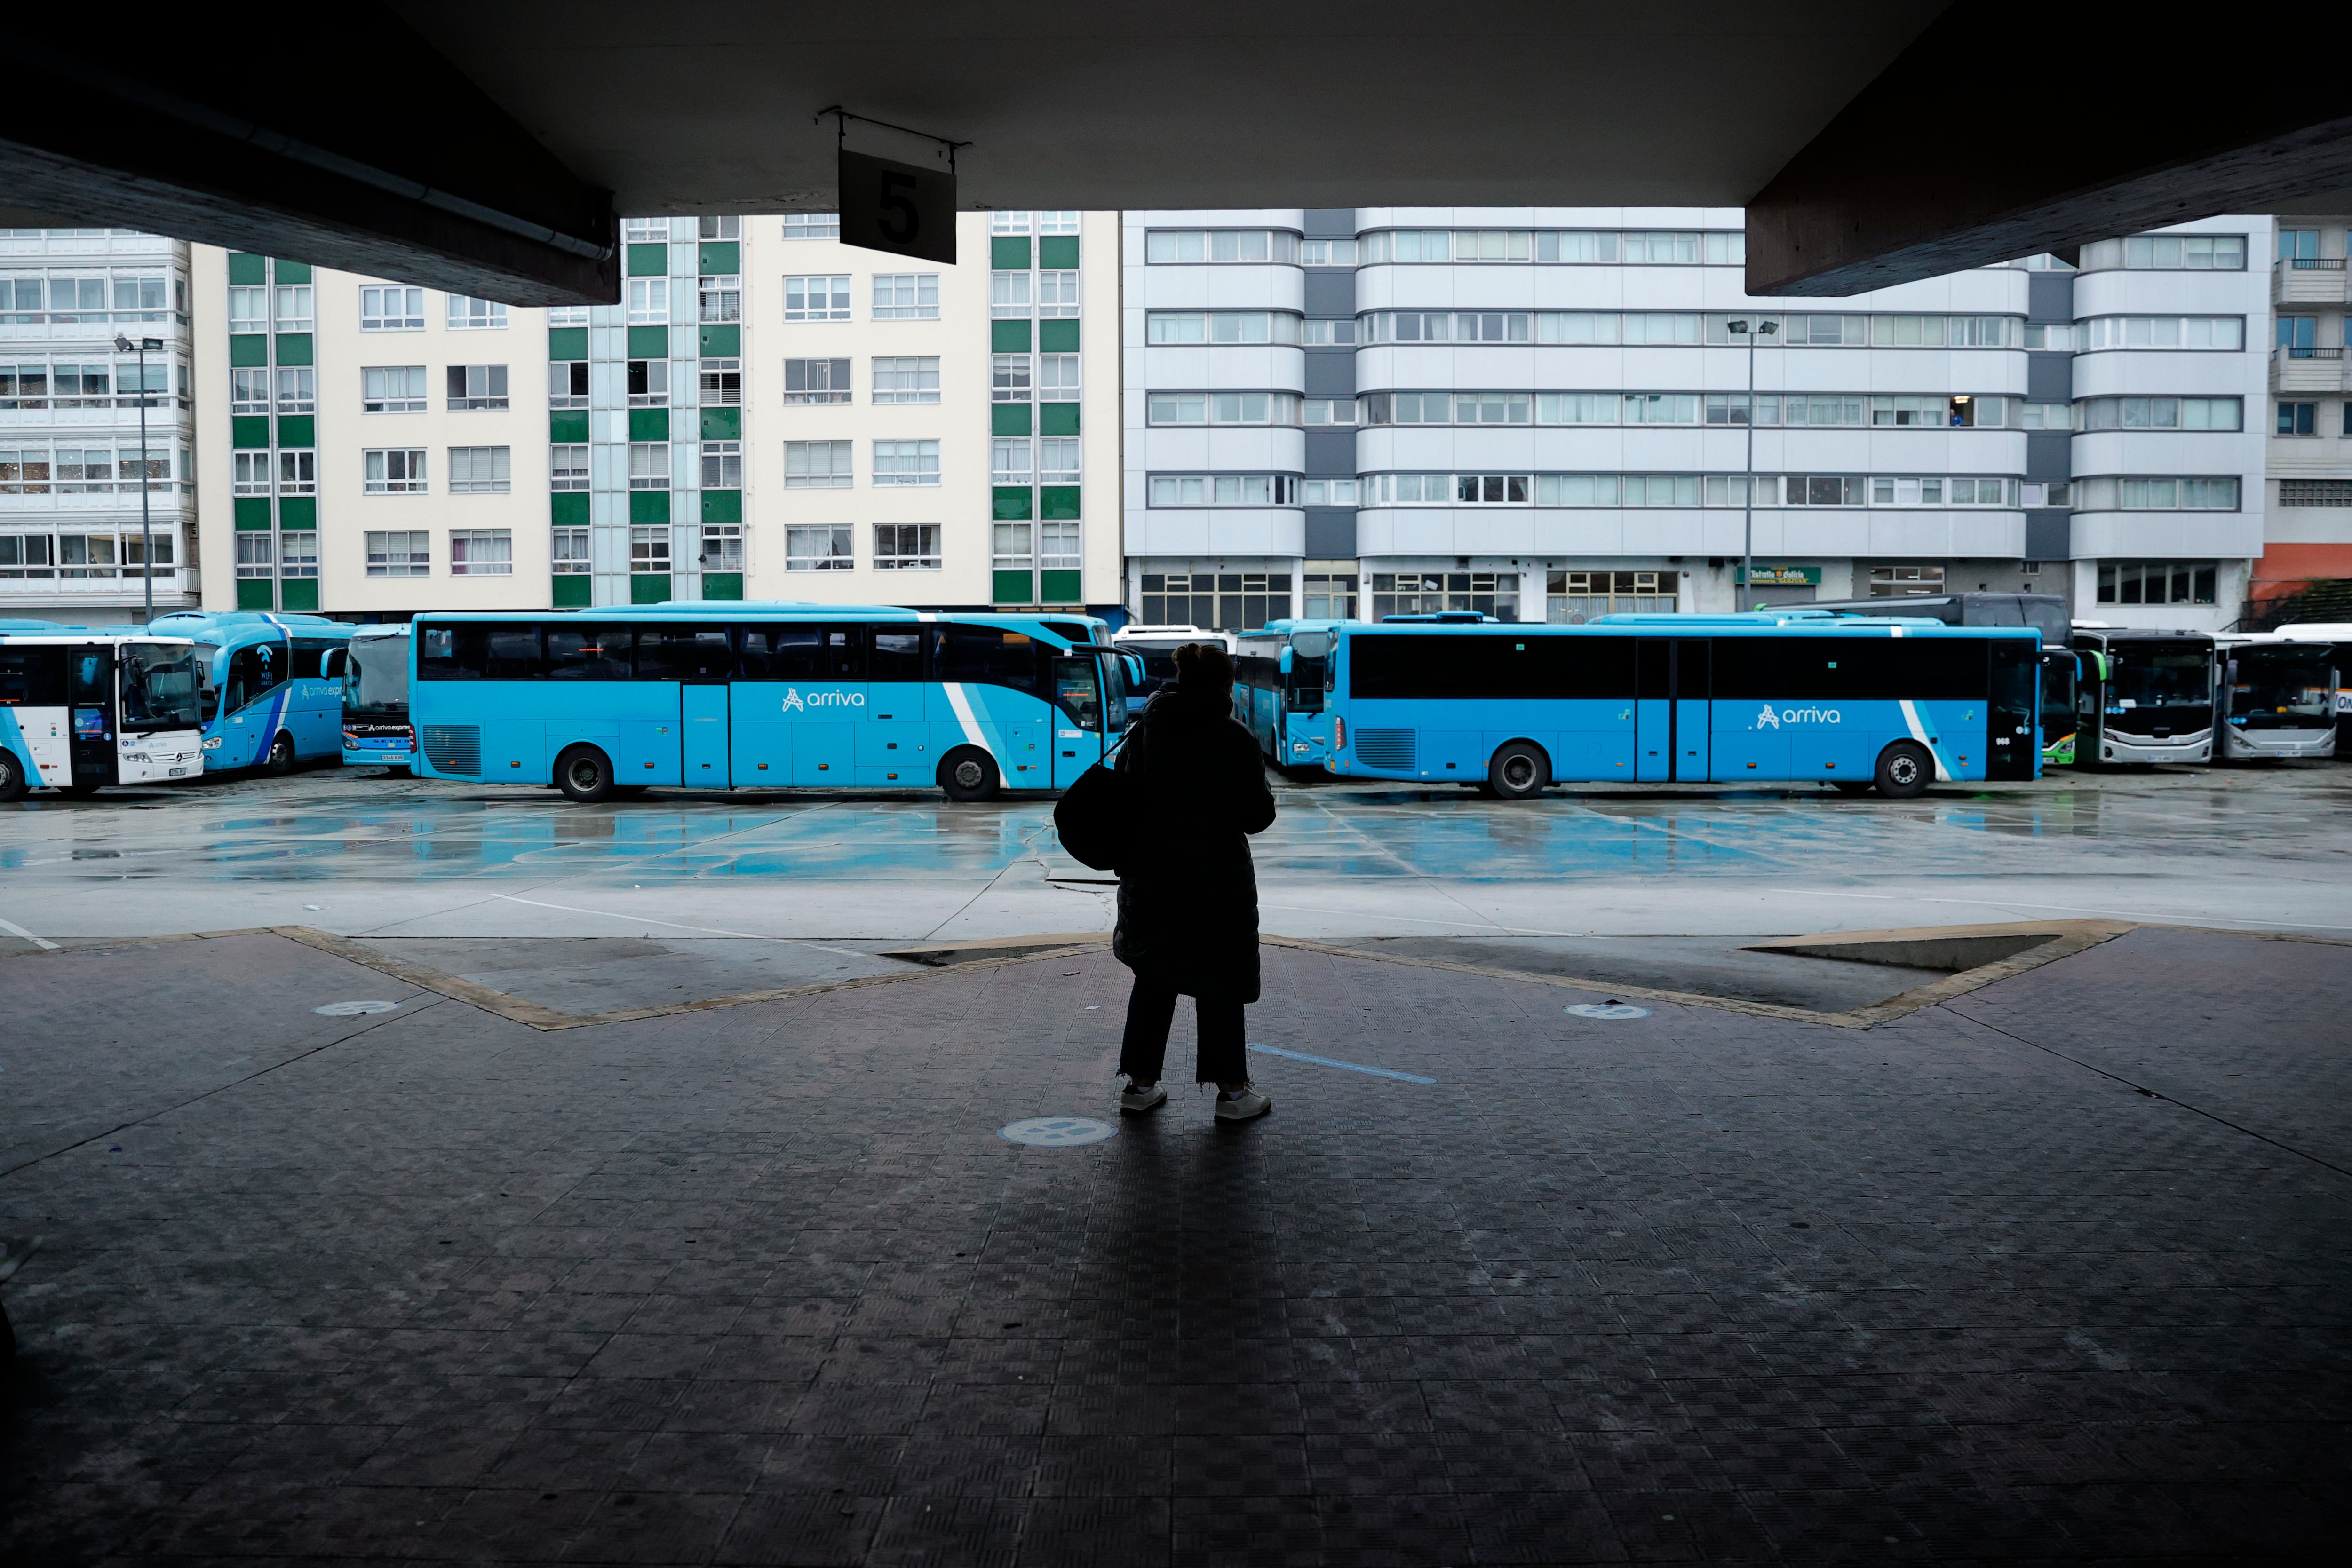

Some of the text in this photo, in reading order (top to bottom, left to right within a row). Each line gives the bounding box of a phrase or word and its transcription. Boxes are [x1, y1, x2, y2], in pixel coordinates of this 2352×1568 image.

[878, 170, 919, 245] 5
[261, 672, 272, 680] WIFI
[328, 687, 342, 697] expr
[807, 689, 865, 706] arriva
[1782, 705, 1840, 723] arriva
